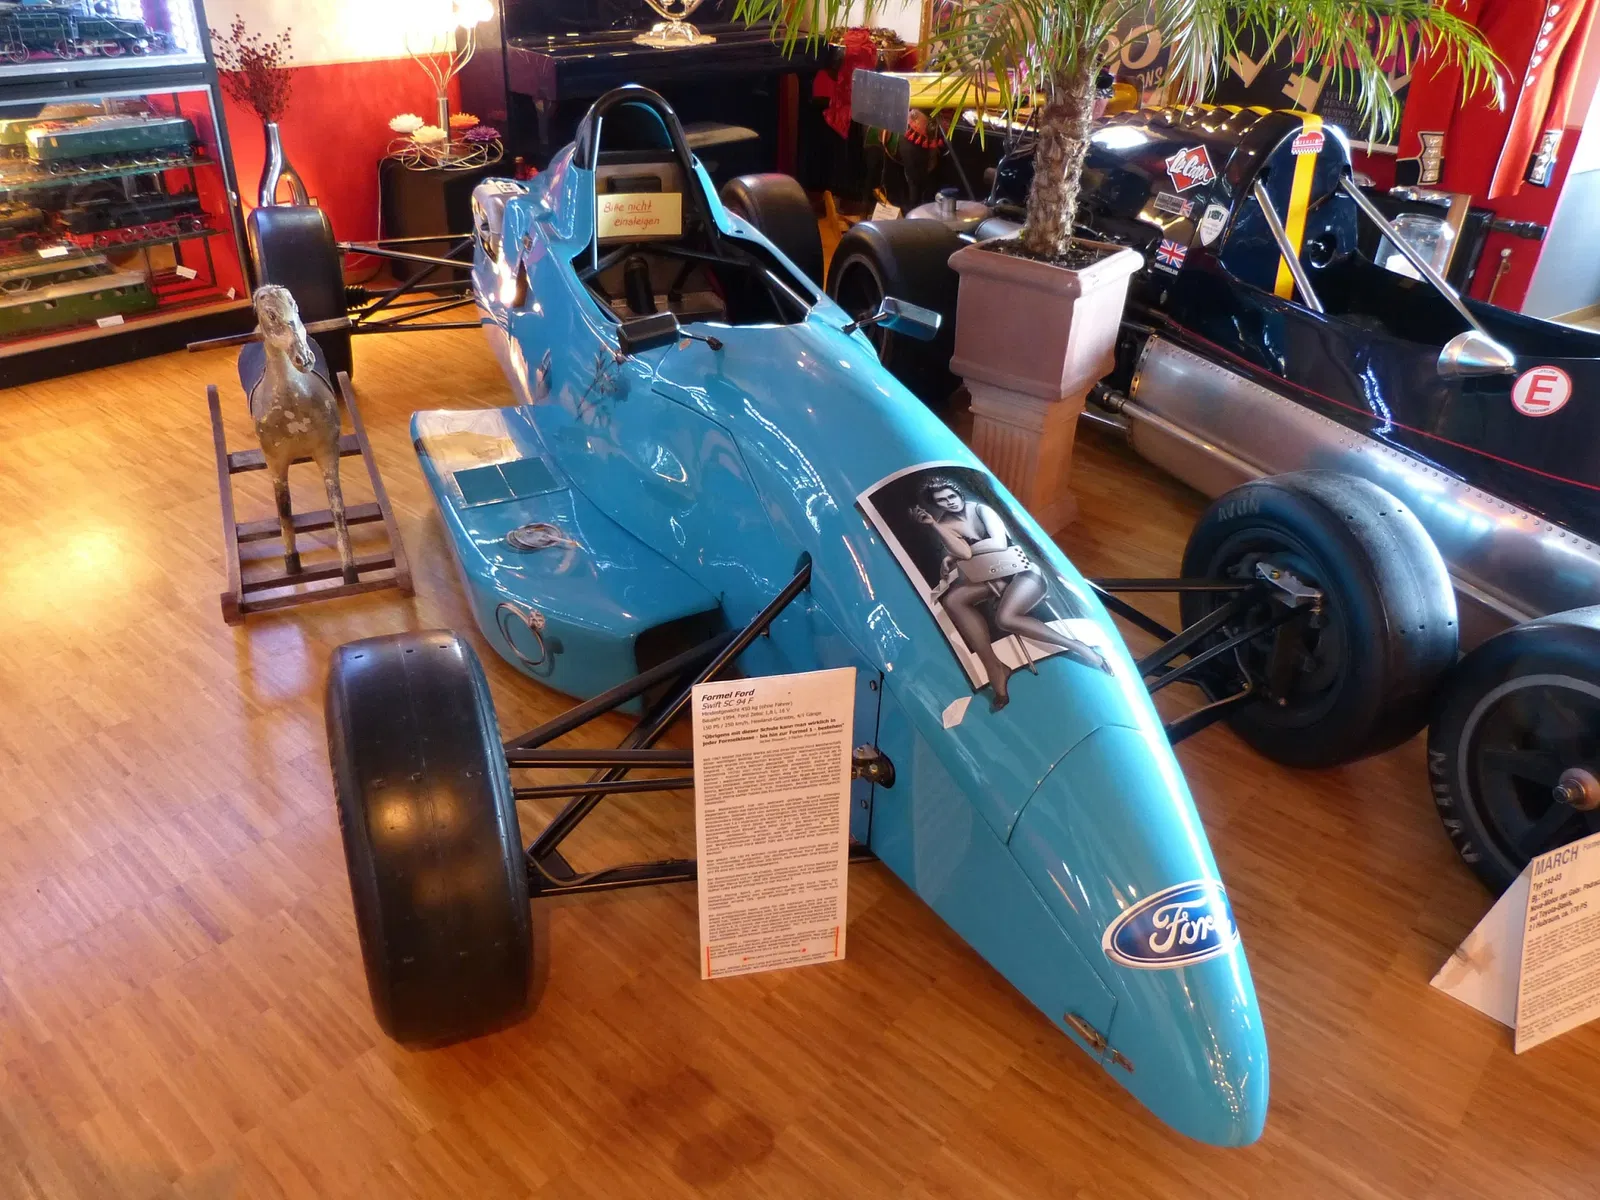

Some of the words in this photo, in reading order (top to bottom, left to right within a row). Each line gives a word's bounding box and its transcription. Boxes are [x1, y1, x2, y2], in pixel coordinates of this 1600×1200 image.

[604, 202, 624, 213] Bitte
[627, 200, 652, 212] nicht
[614, 216, 660, 230] einsteigen
[1525, 375, 1558, 406] E
[701, 692, 733, 701] Formel
[735, 689, 755, 698] Ford
[702, 701, 721, 710] Swift
[723, 699, 734, 707] SC
[736, 698, 746, 706] 94
[1534, 845, 1579, 876] MARCH
[1533, 881, 1543, 890] Typ
[1149, 896, 1230, 953] For
